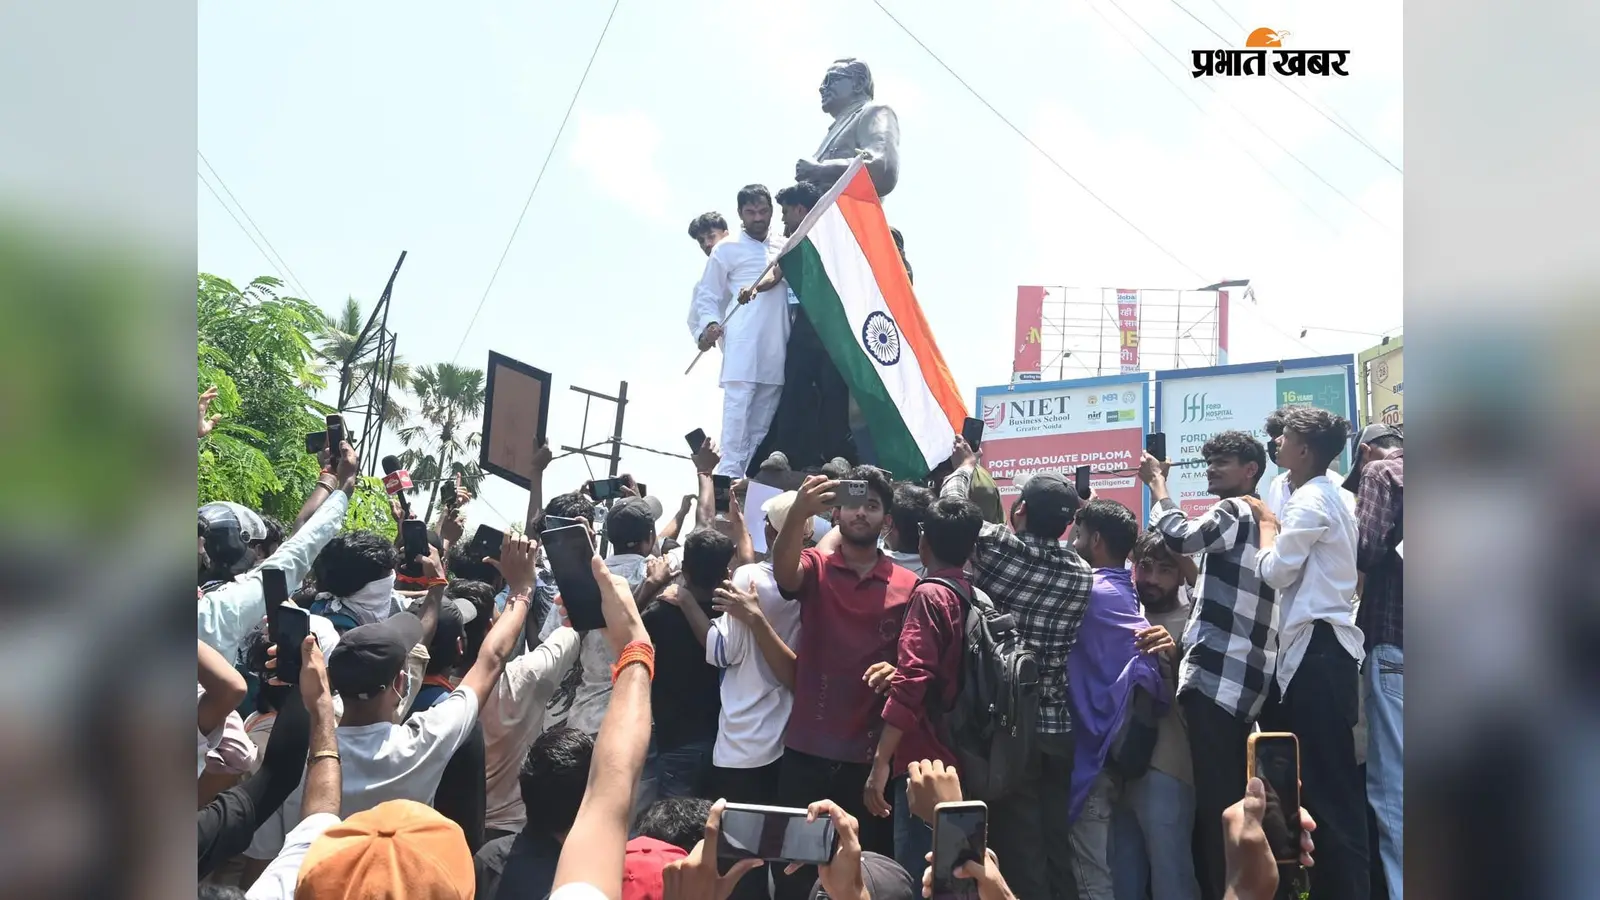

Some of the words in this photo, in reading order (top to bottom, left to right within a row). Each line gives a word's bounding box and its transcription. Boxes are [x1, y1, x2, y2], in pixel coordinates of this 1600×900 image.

[1282, 390, 1296, 402] 16
[1010, 396, 1071, 418] NIET
[1009, 418, 1041, 426] Business
[1043, 413, 1070, 423] School
[1180, 433, 1208, 443] FORD
[988, 460, 1016, 468] POST
[1018, 454, 1079, 465] GRADUATE
[1081, 450, 1132, 461] DIPLOMA
[992, 470, 1003, 478] IN
